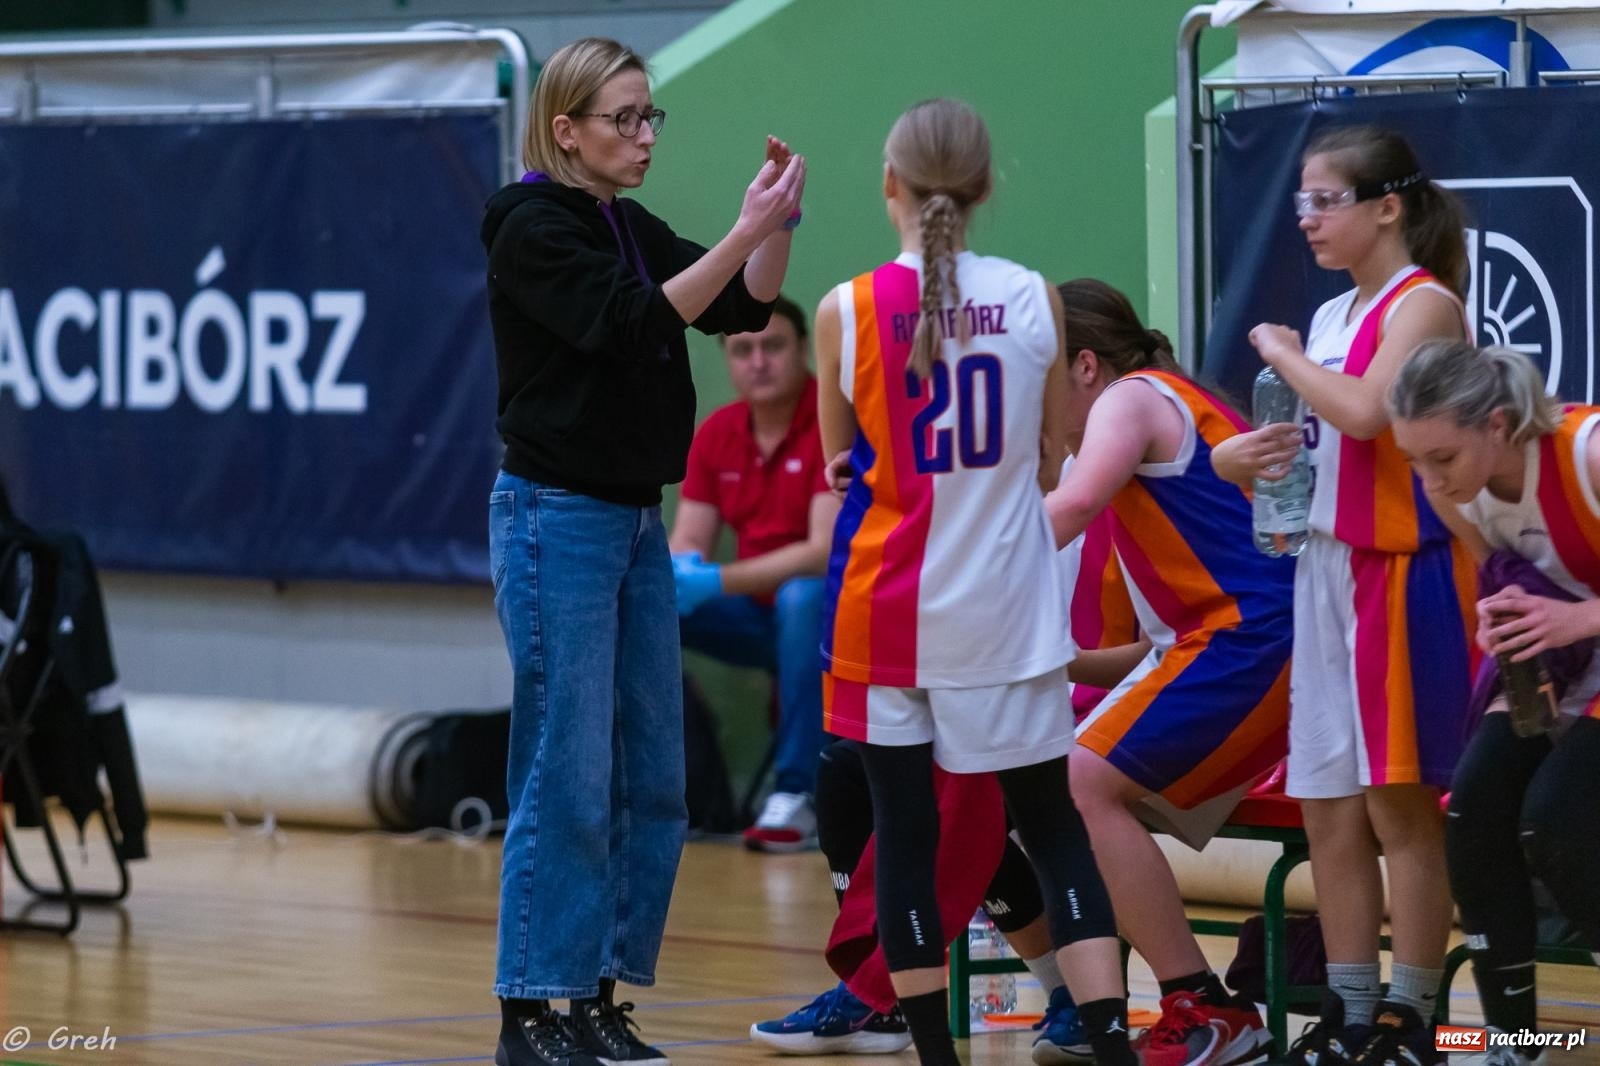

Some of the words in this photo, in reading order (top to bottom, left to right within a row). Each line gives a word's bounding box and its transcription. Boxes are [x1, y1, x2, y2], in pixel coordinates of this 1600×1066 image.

[905, 354, 1003, 474] 20
[1067, 888, 1083, 920] TARMAK
[909, 909, 925, 945] TARMAK
